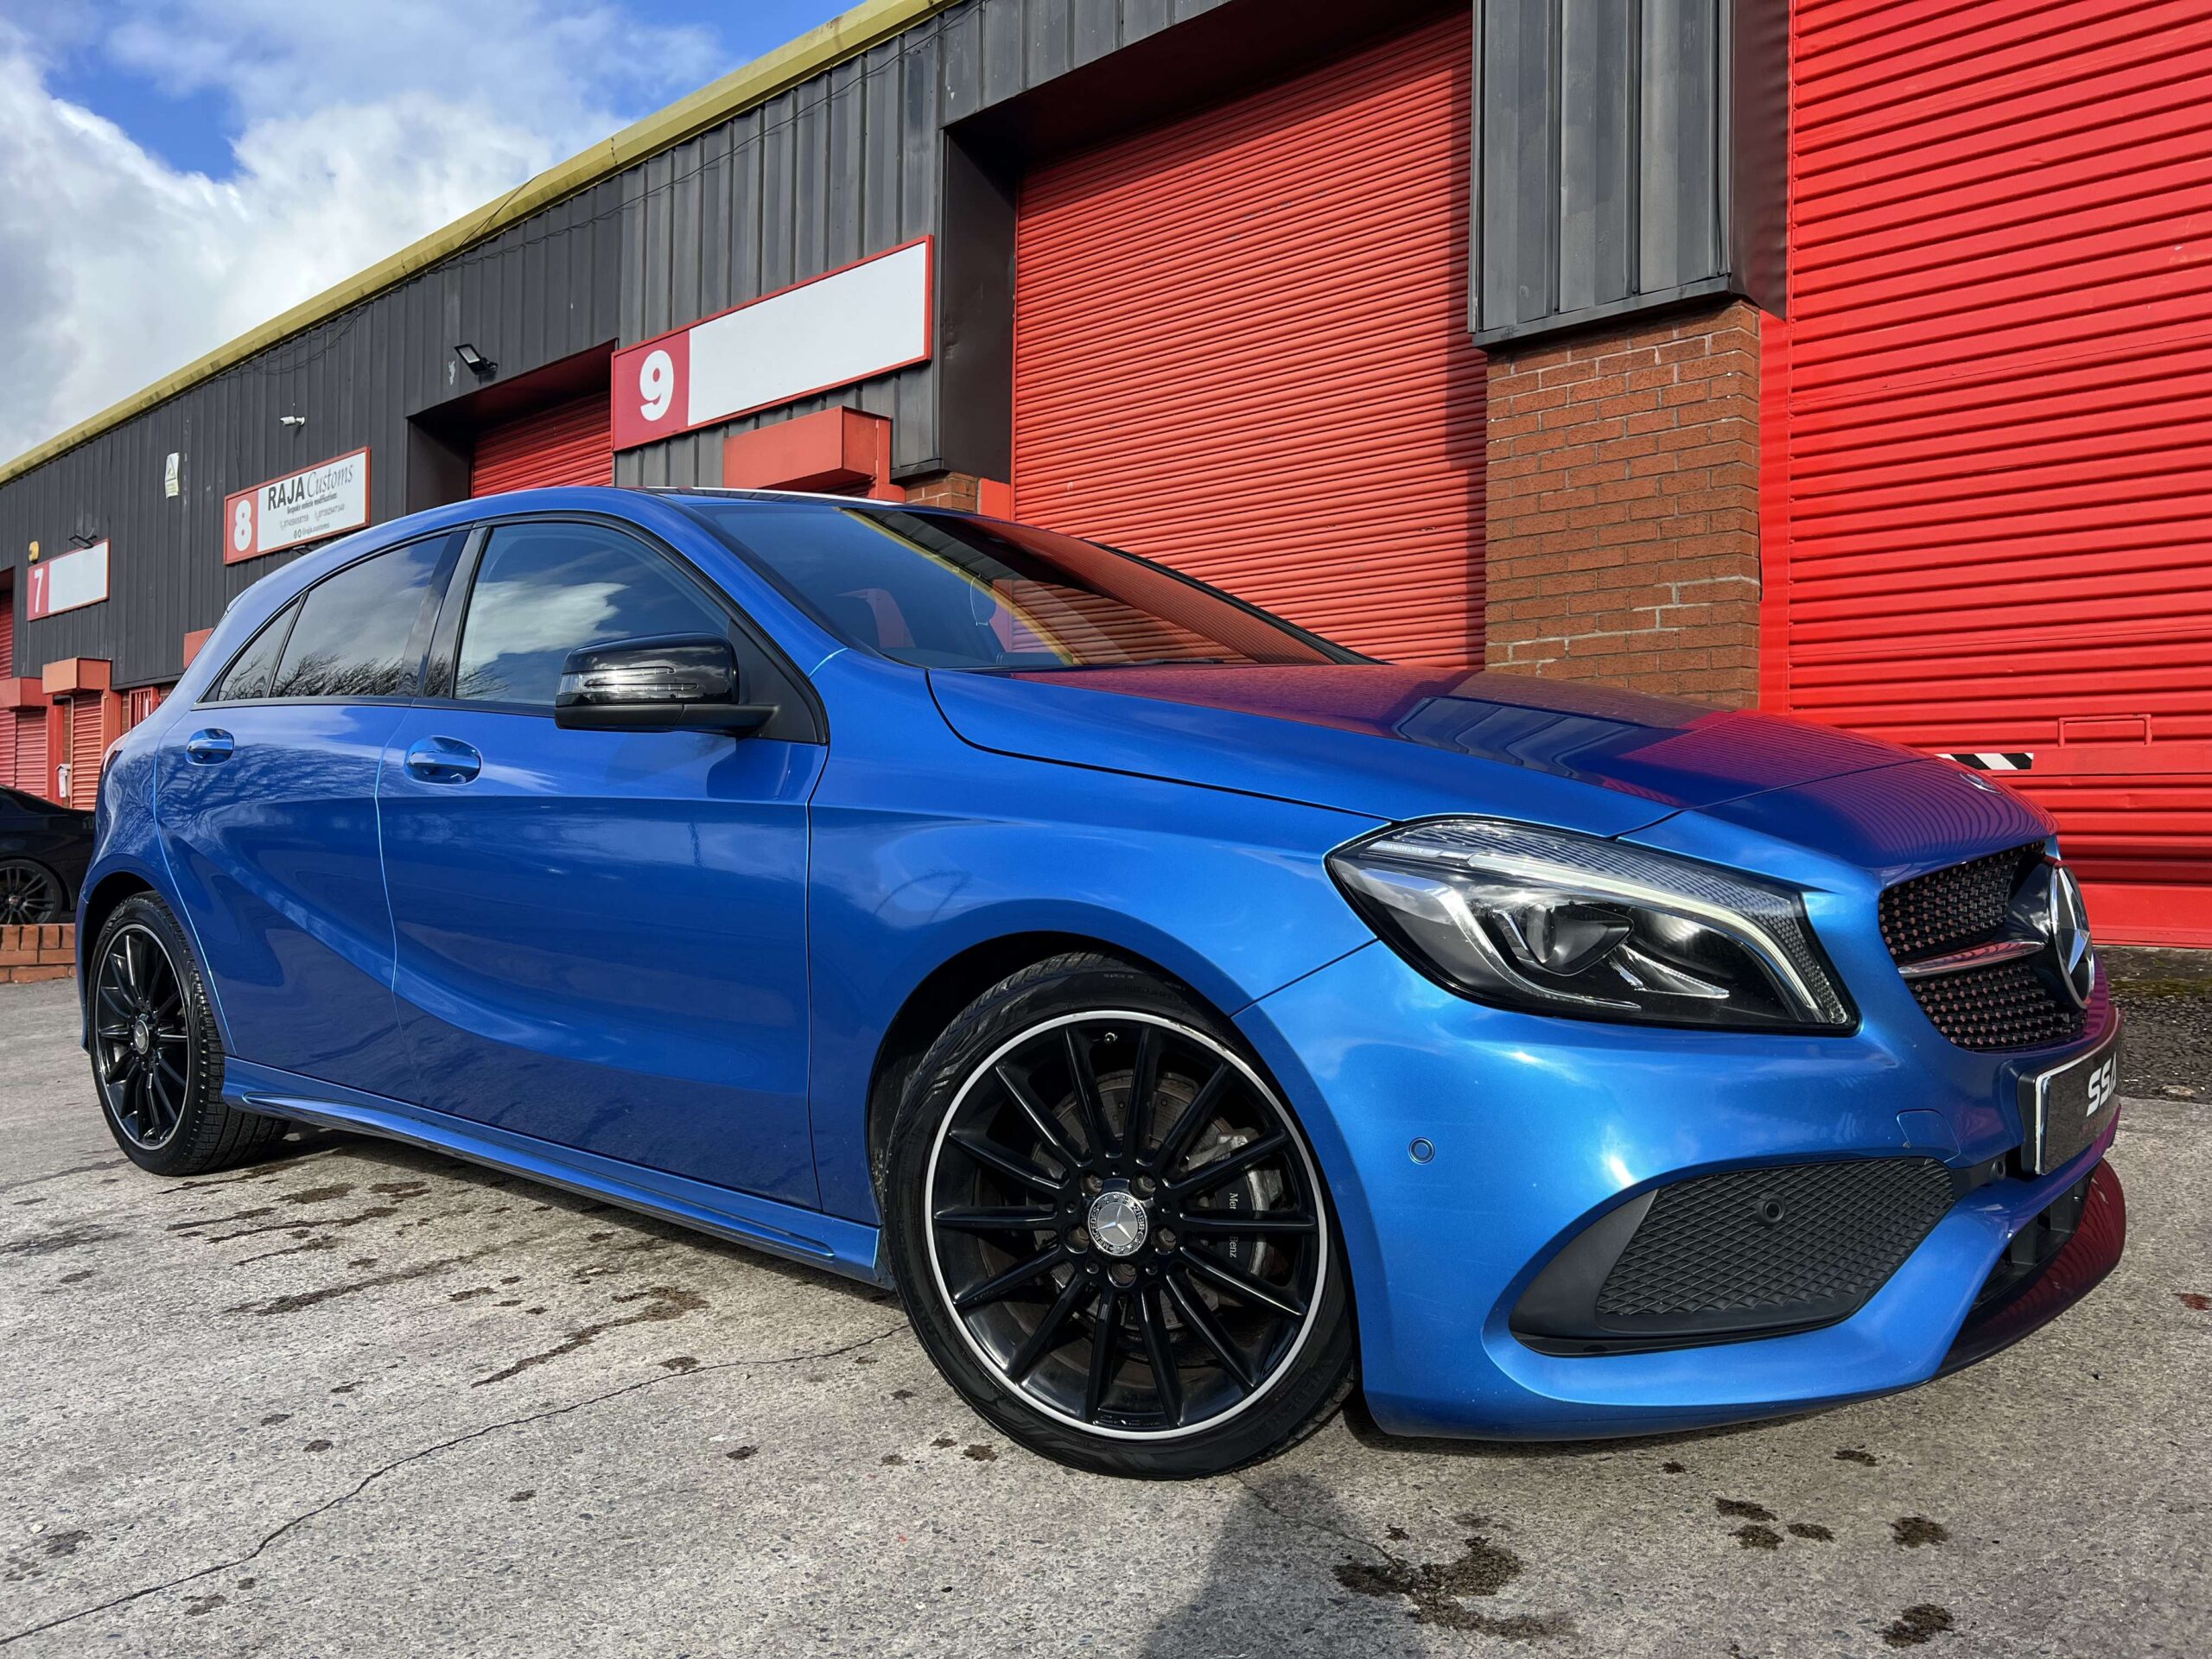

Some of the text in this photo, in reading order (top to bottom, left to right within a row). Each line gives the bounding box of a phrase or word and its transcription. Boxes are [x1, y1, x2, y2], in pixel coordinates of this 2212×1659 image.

[639, 350, 674, 421] 9
[268, 465, 353, 511] RAJA Customs
[234, 499, 252, 551] 8
[35, 568, 44, 613] 7
[1090, 1205, 1145, 1250] MERCEDES BENZ
